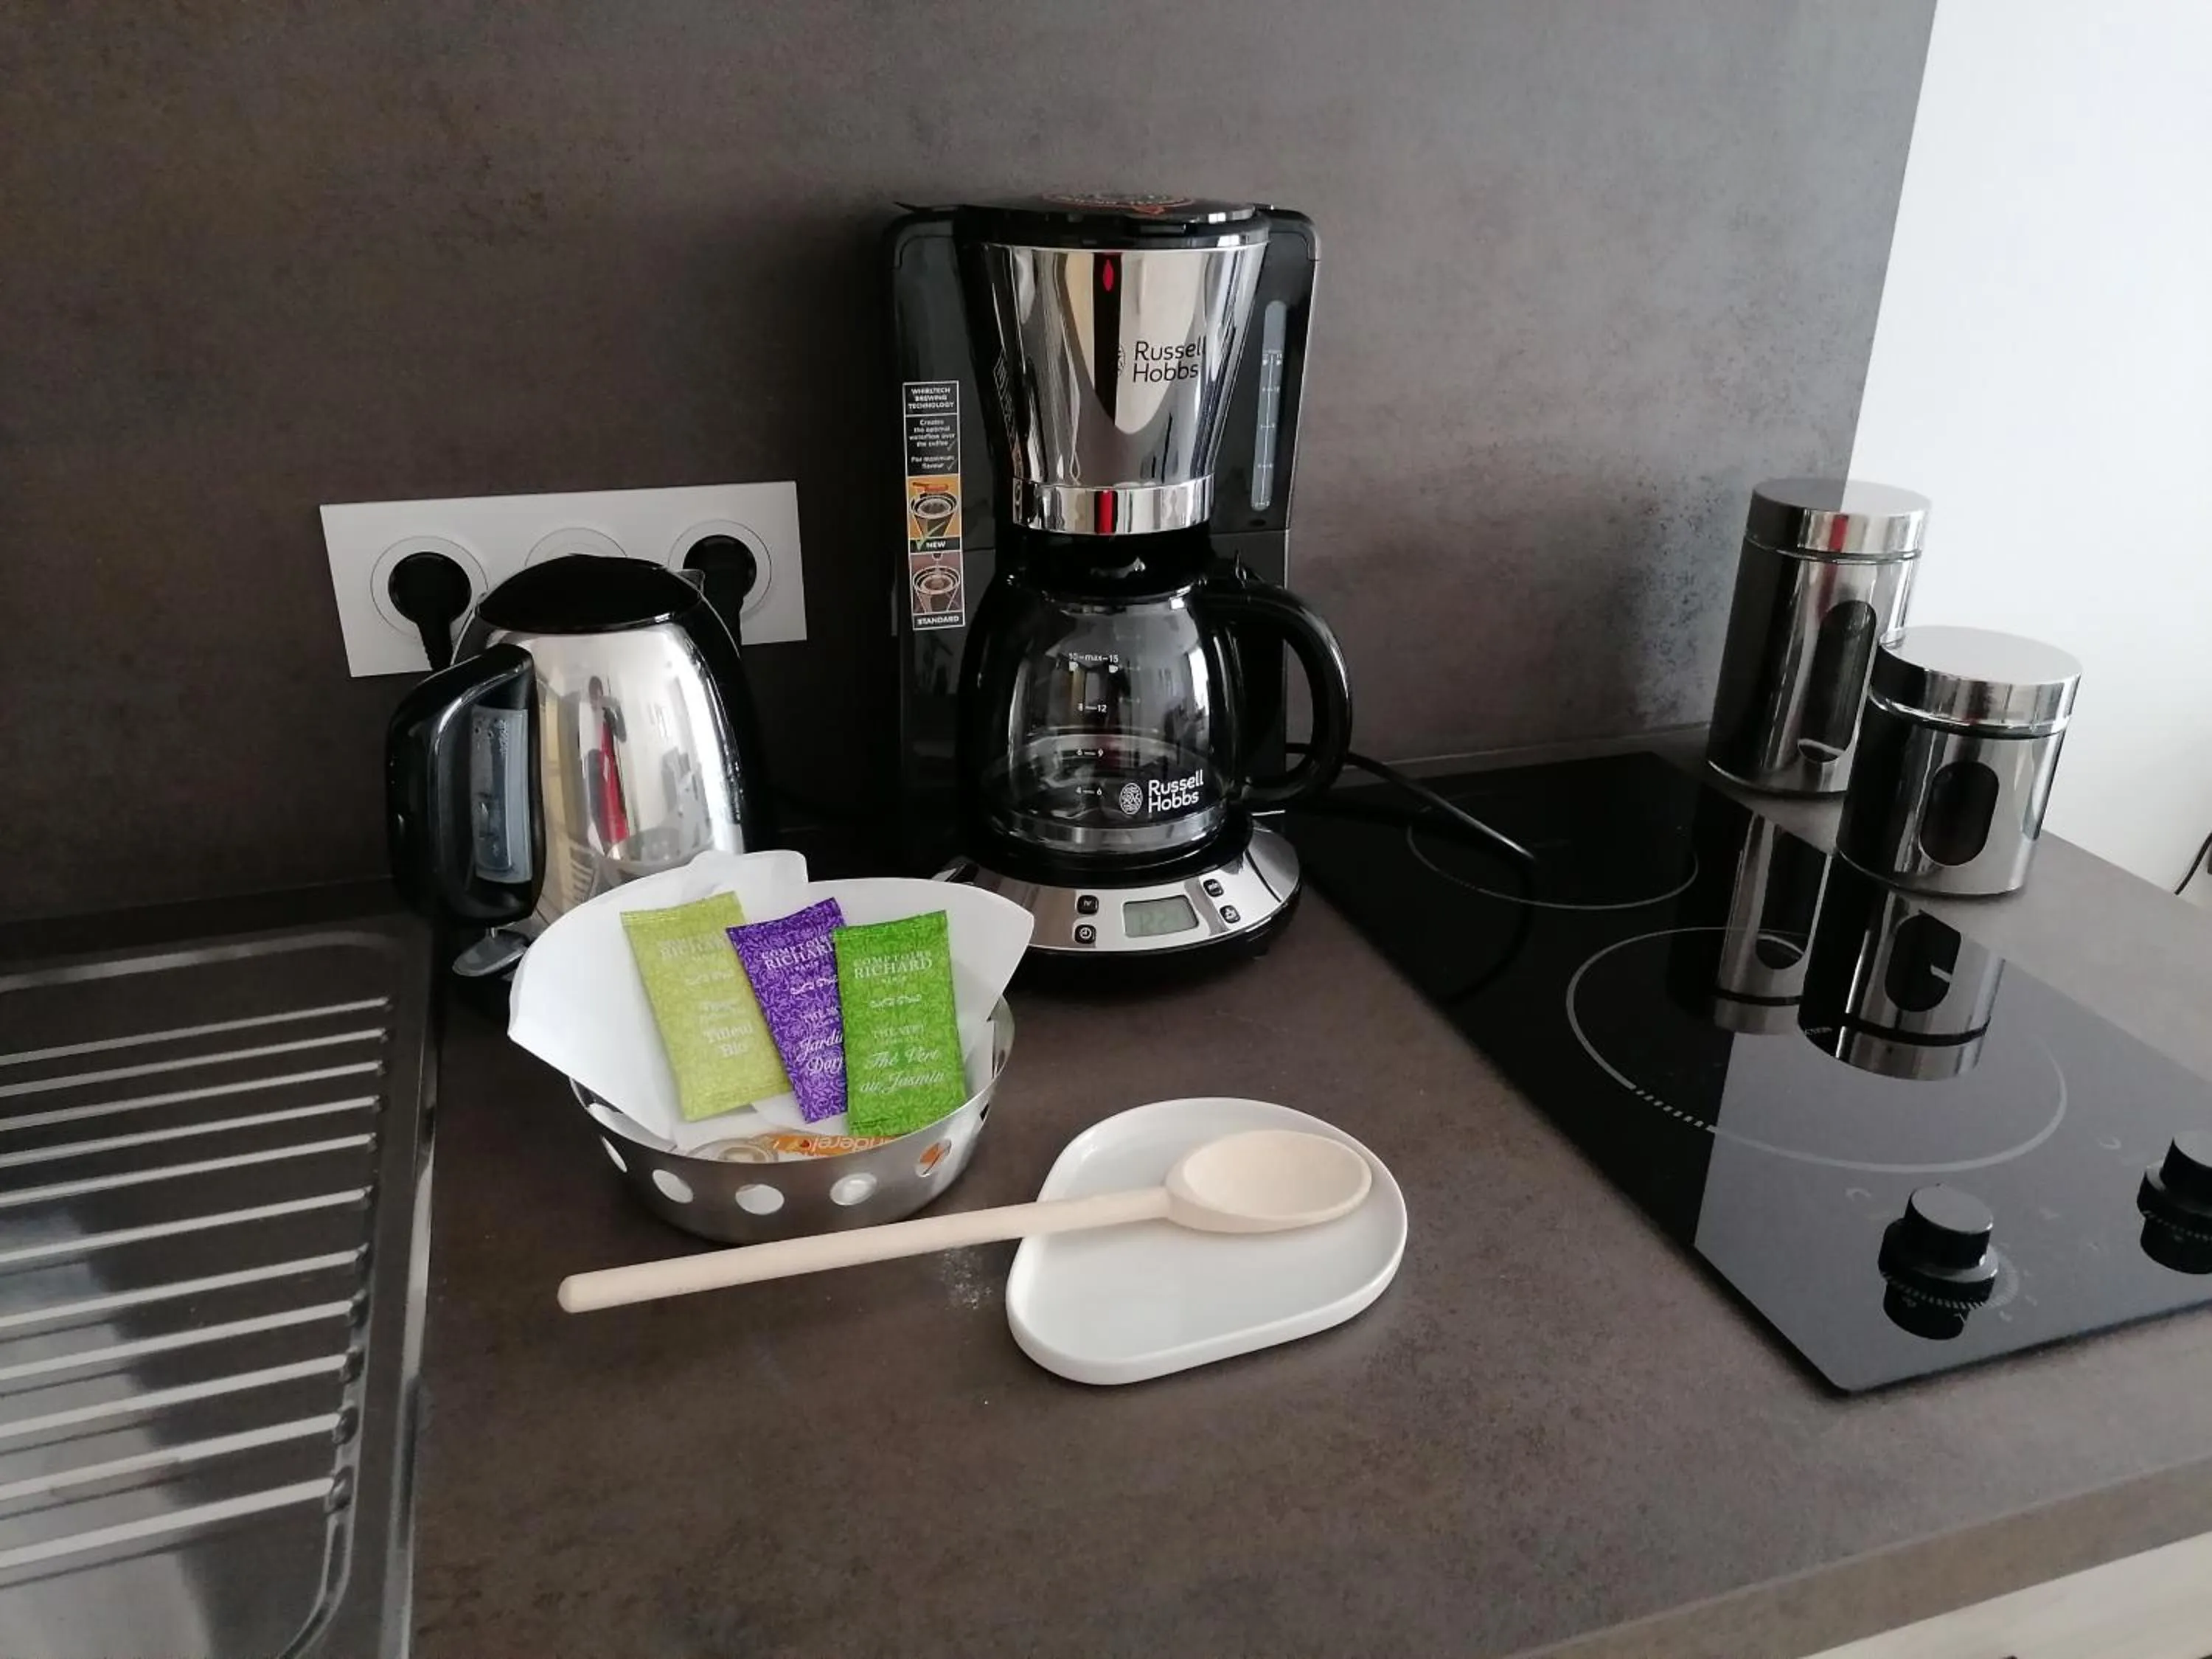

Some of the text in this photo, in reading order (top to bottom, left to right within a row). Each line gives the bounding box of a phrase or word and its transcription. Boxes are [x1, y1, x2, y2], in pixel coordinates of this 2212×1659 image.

[1134, 335, 1206, 361] Russell
[1133, 361, 1199, 383] Hobbs
[926, 540, 946, 549] NEW
[917, 616, 959, 625] STANDARD
[1109, 654, 1119, 663] 15
[1097, 704, 1107, 713] 12
[1098, 748, 1104, 757] 9
[1096, 787, 1102, 796] 6
[1148, 769, 1204, 796] Russell
[1148, 790, 1199, 813] Hobbs
[855, 959, 933, 980] RICHARD
[796, 1028, 843, 1062] Jardi
[807, 1057, 843, 1077] Darj
[812, 1136, 888, 1153] nderel
